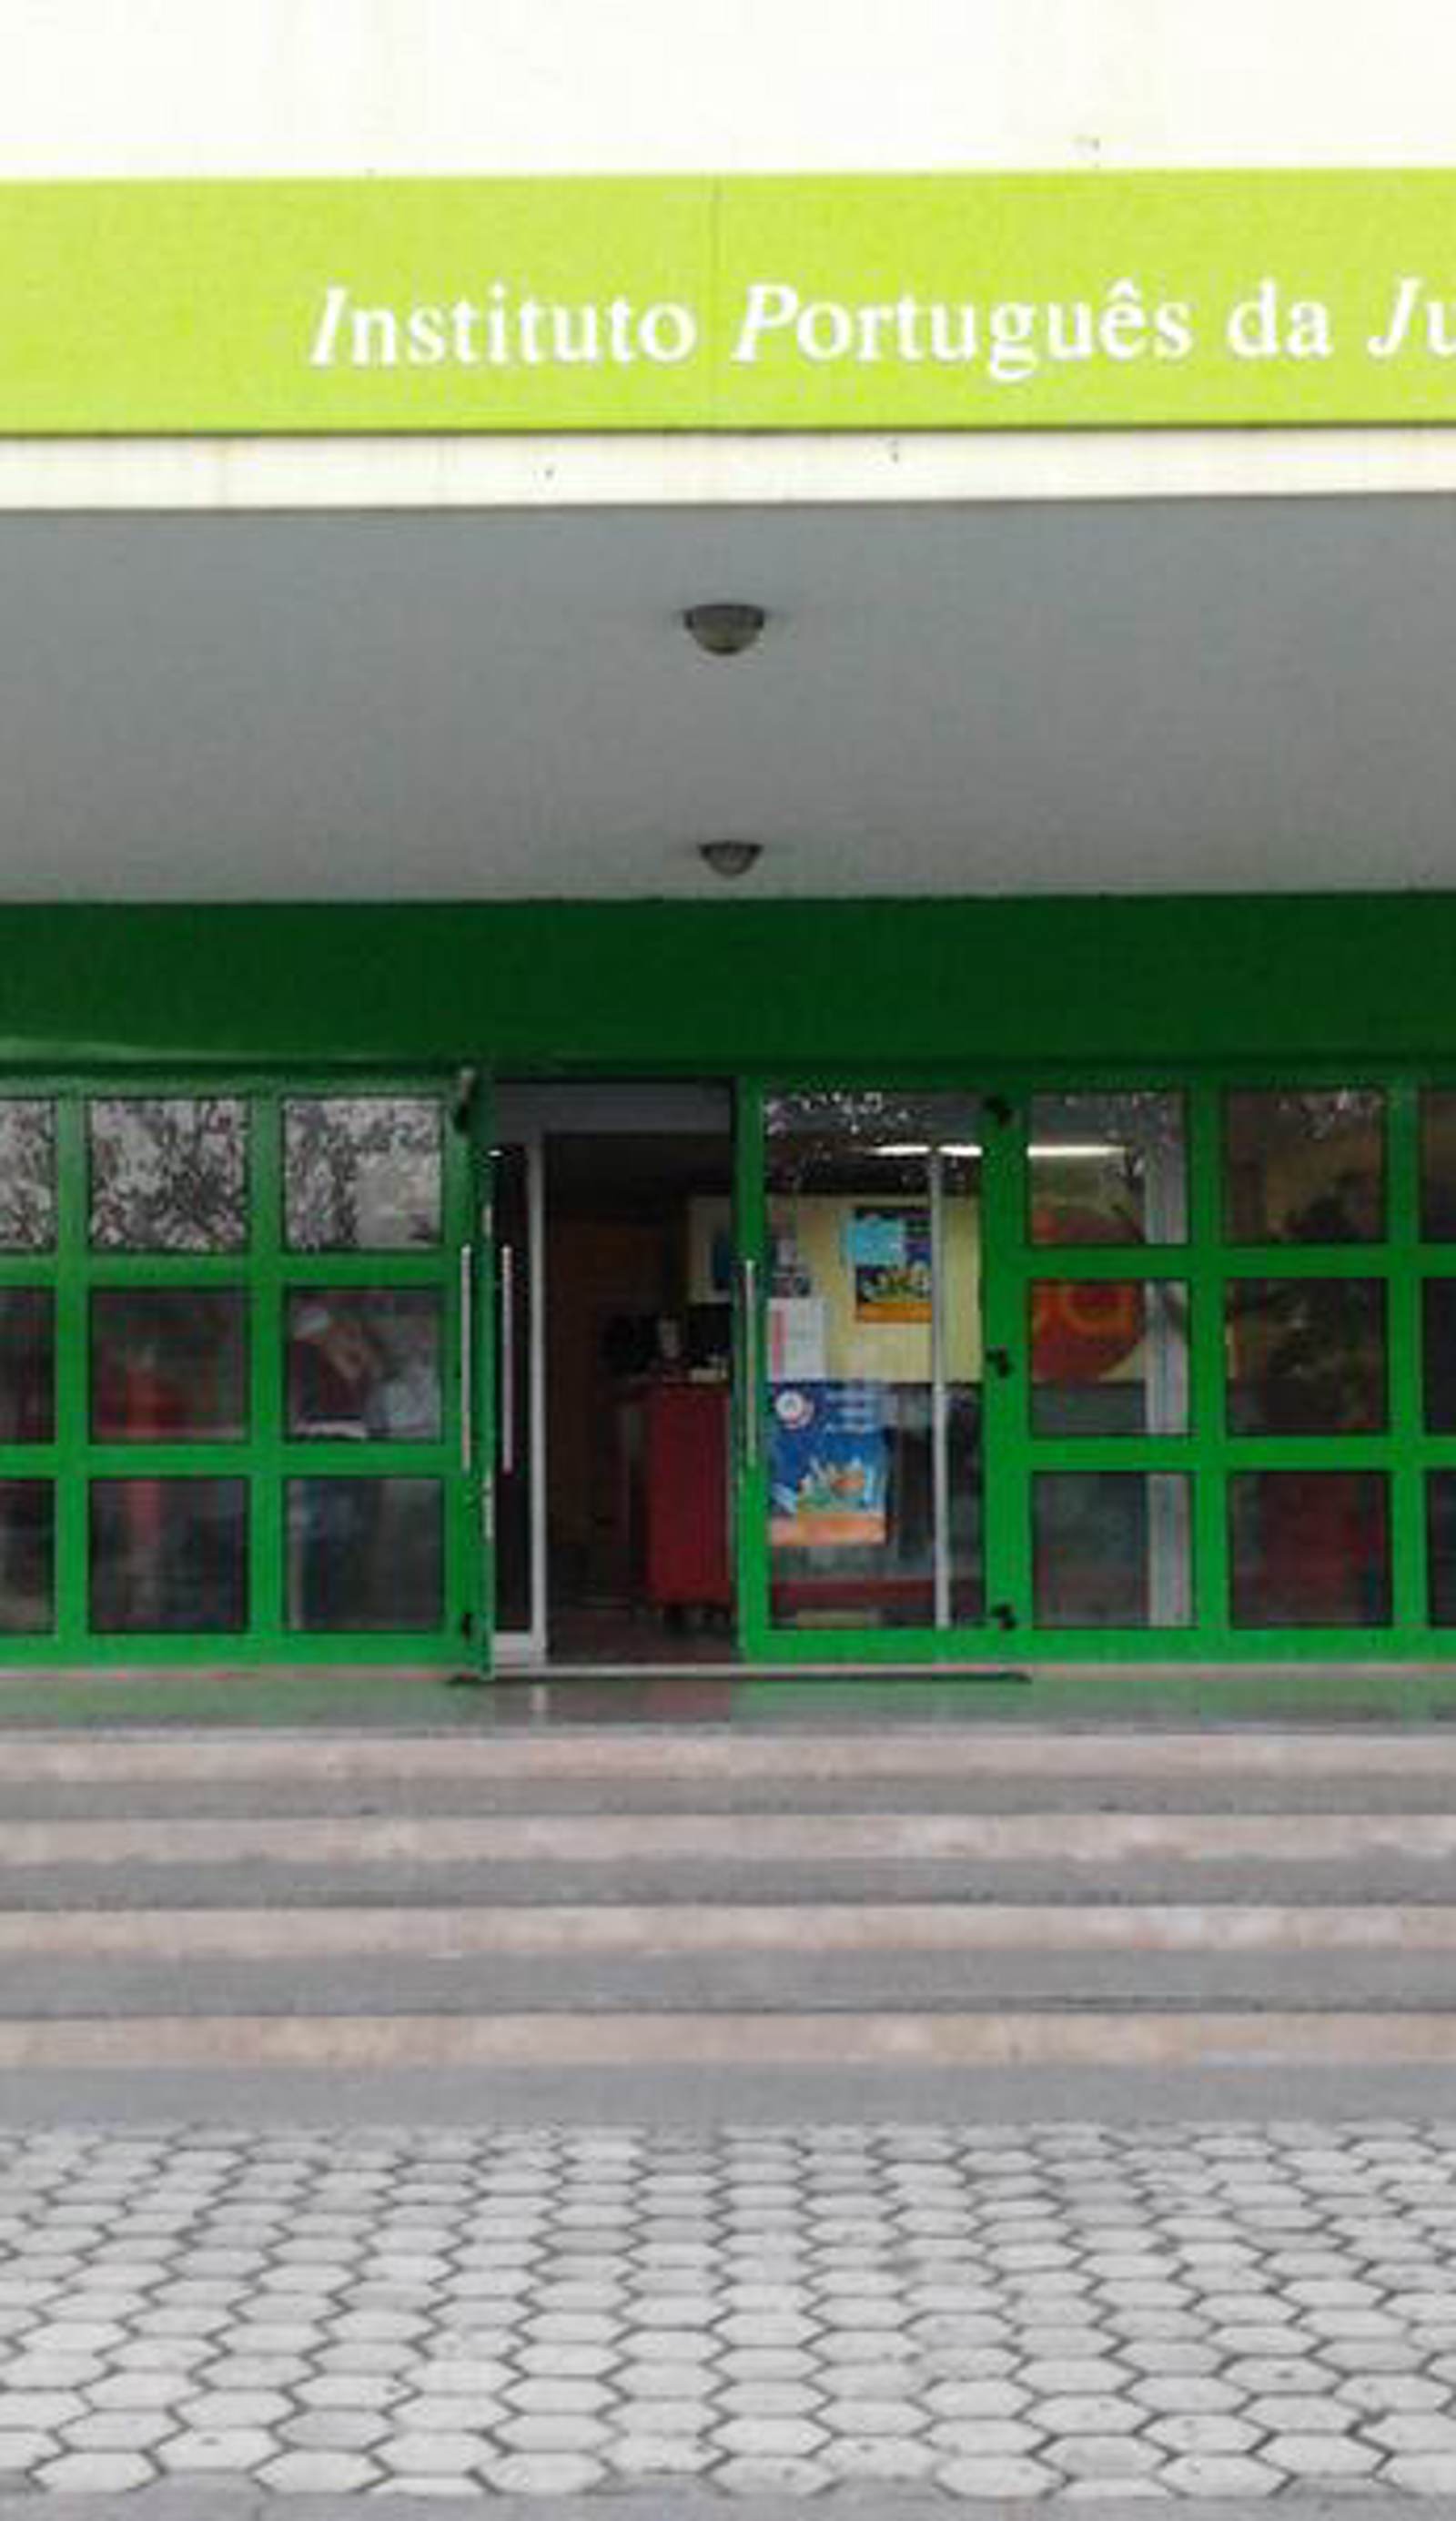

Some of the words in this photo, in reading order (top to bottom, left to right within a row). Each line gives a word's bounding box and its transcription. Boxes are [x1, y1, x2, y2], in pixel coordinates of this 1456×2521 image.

[308, 280, 699, 366] Instituto
[732, 277, 1194, 382] Português
[1226, 276, 1334, 359] da
